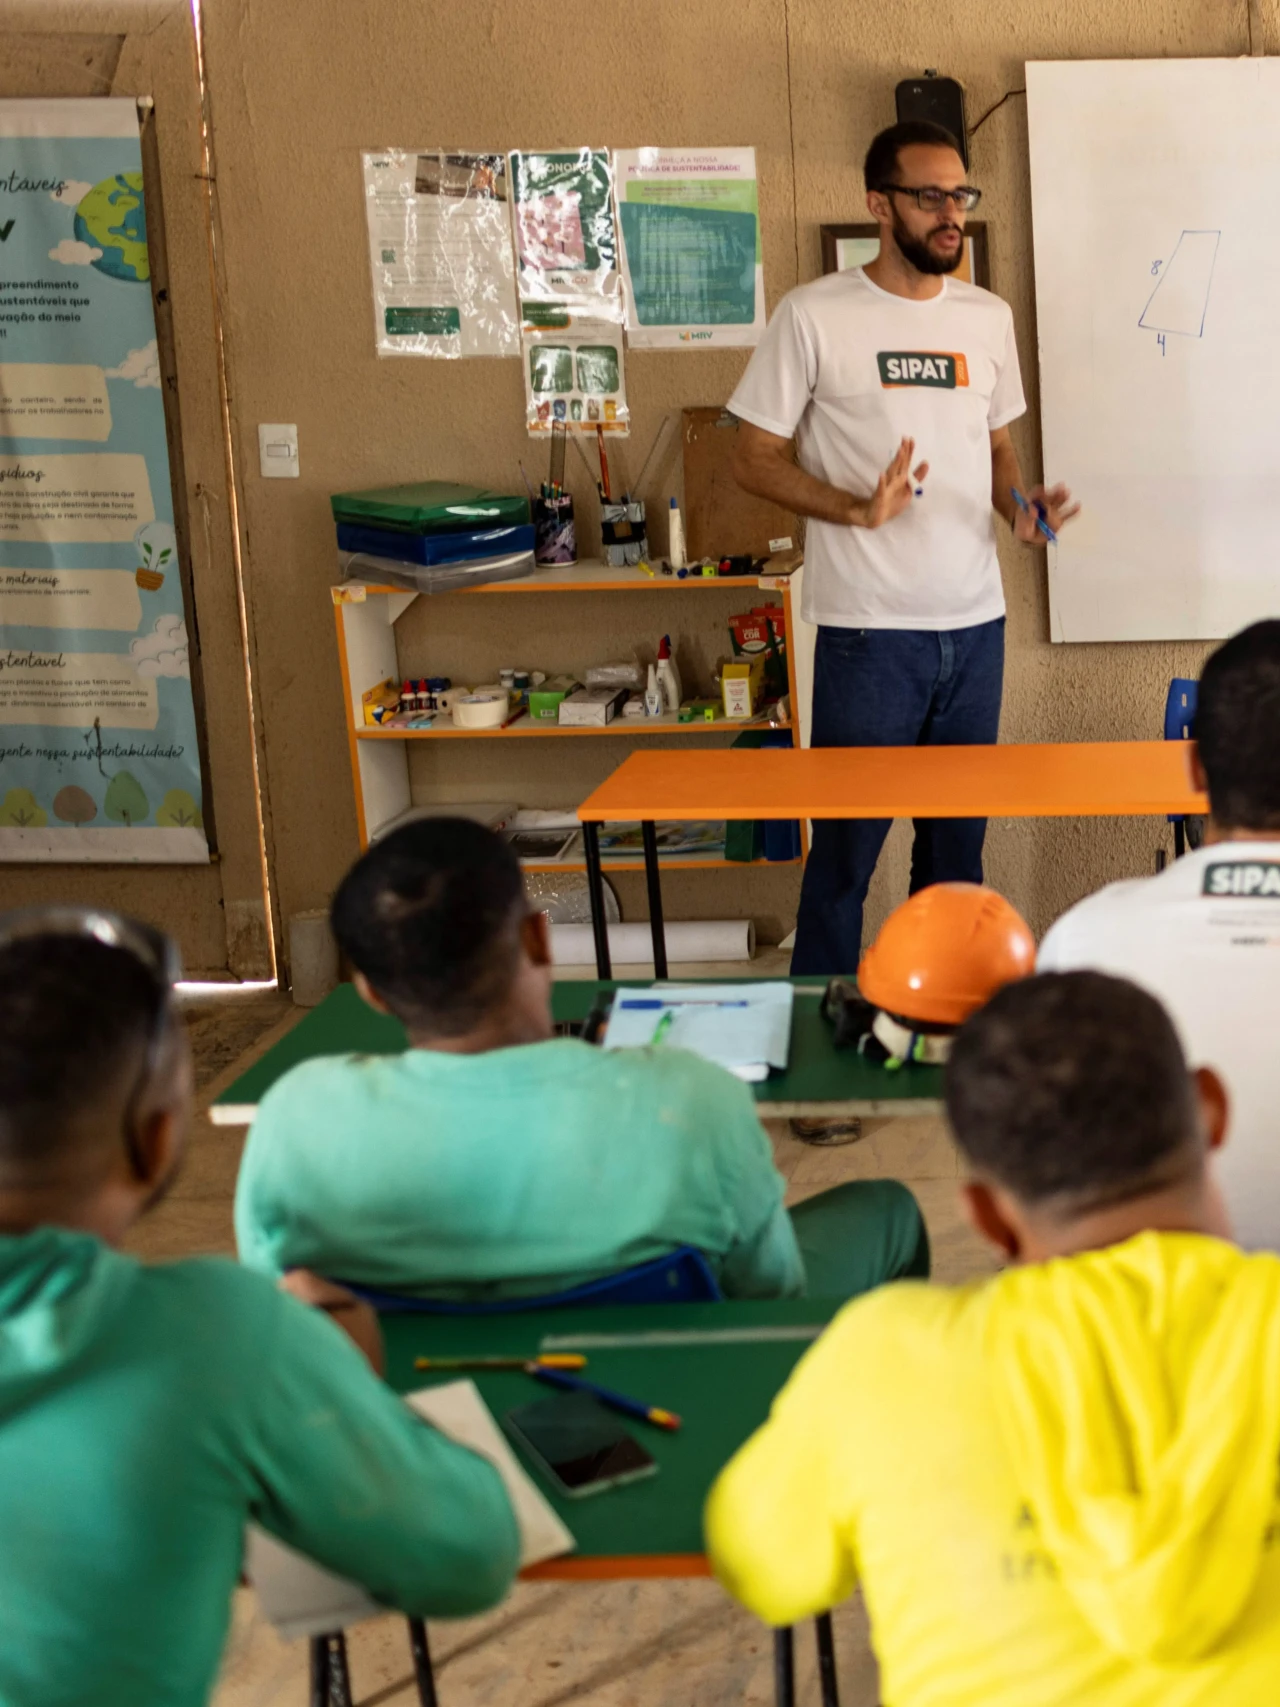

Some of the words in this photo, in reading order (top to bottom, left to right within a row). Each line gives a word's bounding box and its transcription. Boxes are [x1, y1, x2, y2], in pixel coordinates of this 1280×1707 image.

[1150, 259, 1163, 276] 8
[69, 297, 90, 307] que
[38, 312, 52, 322] do
[54, 312, 81, 322] meio
[1156, 332, 1166, 357] 4
[885, 356, 949, 380] SIPAT
